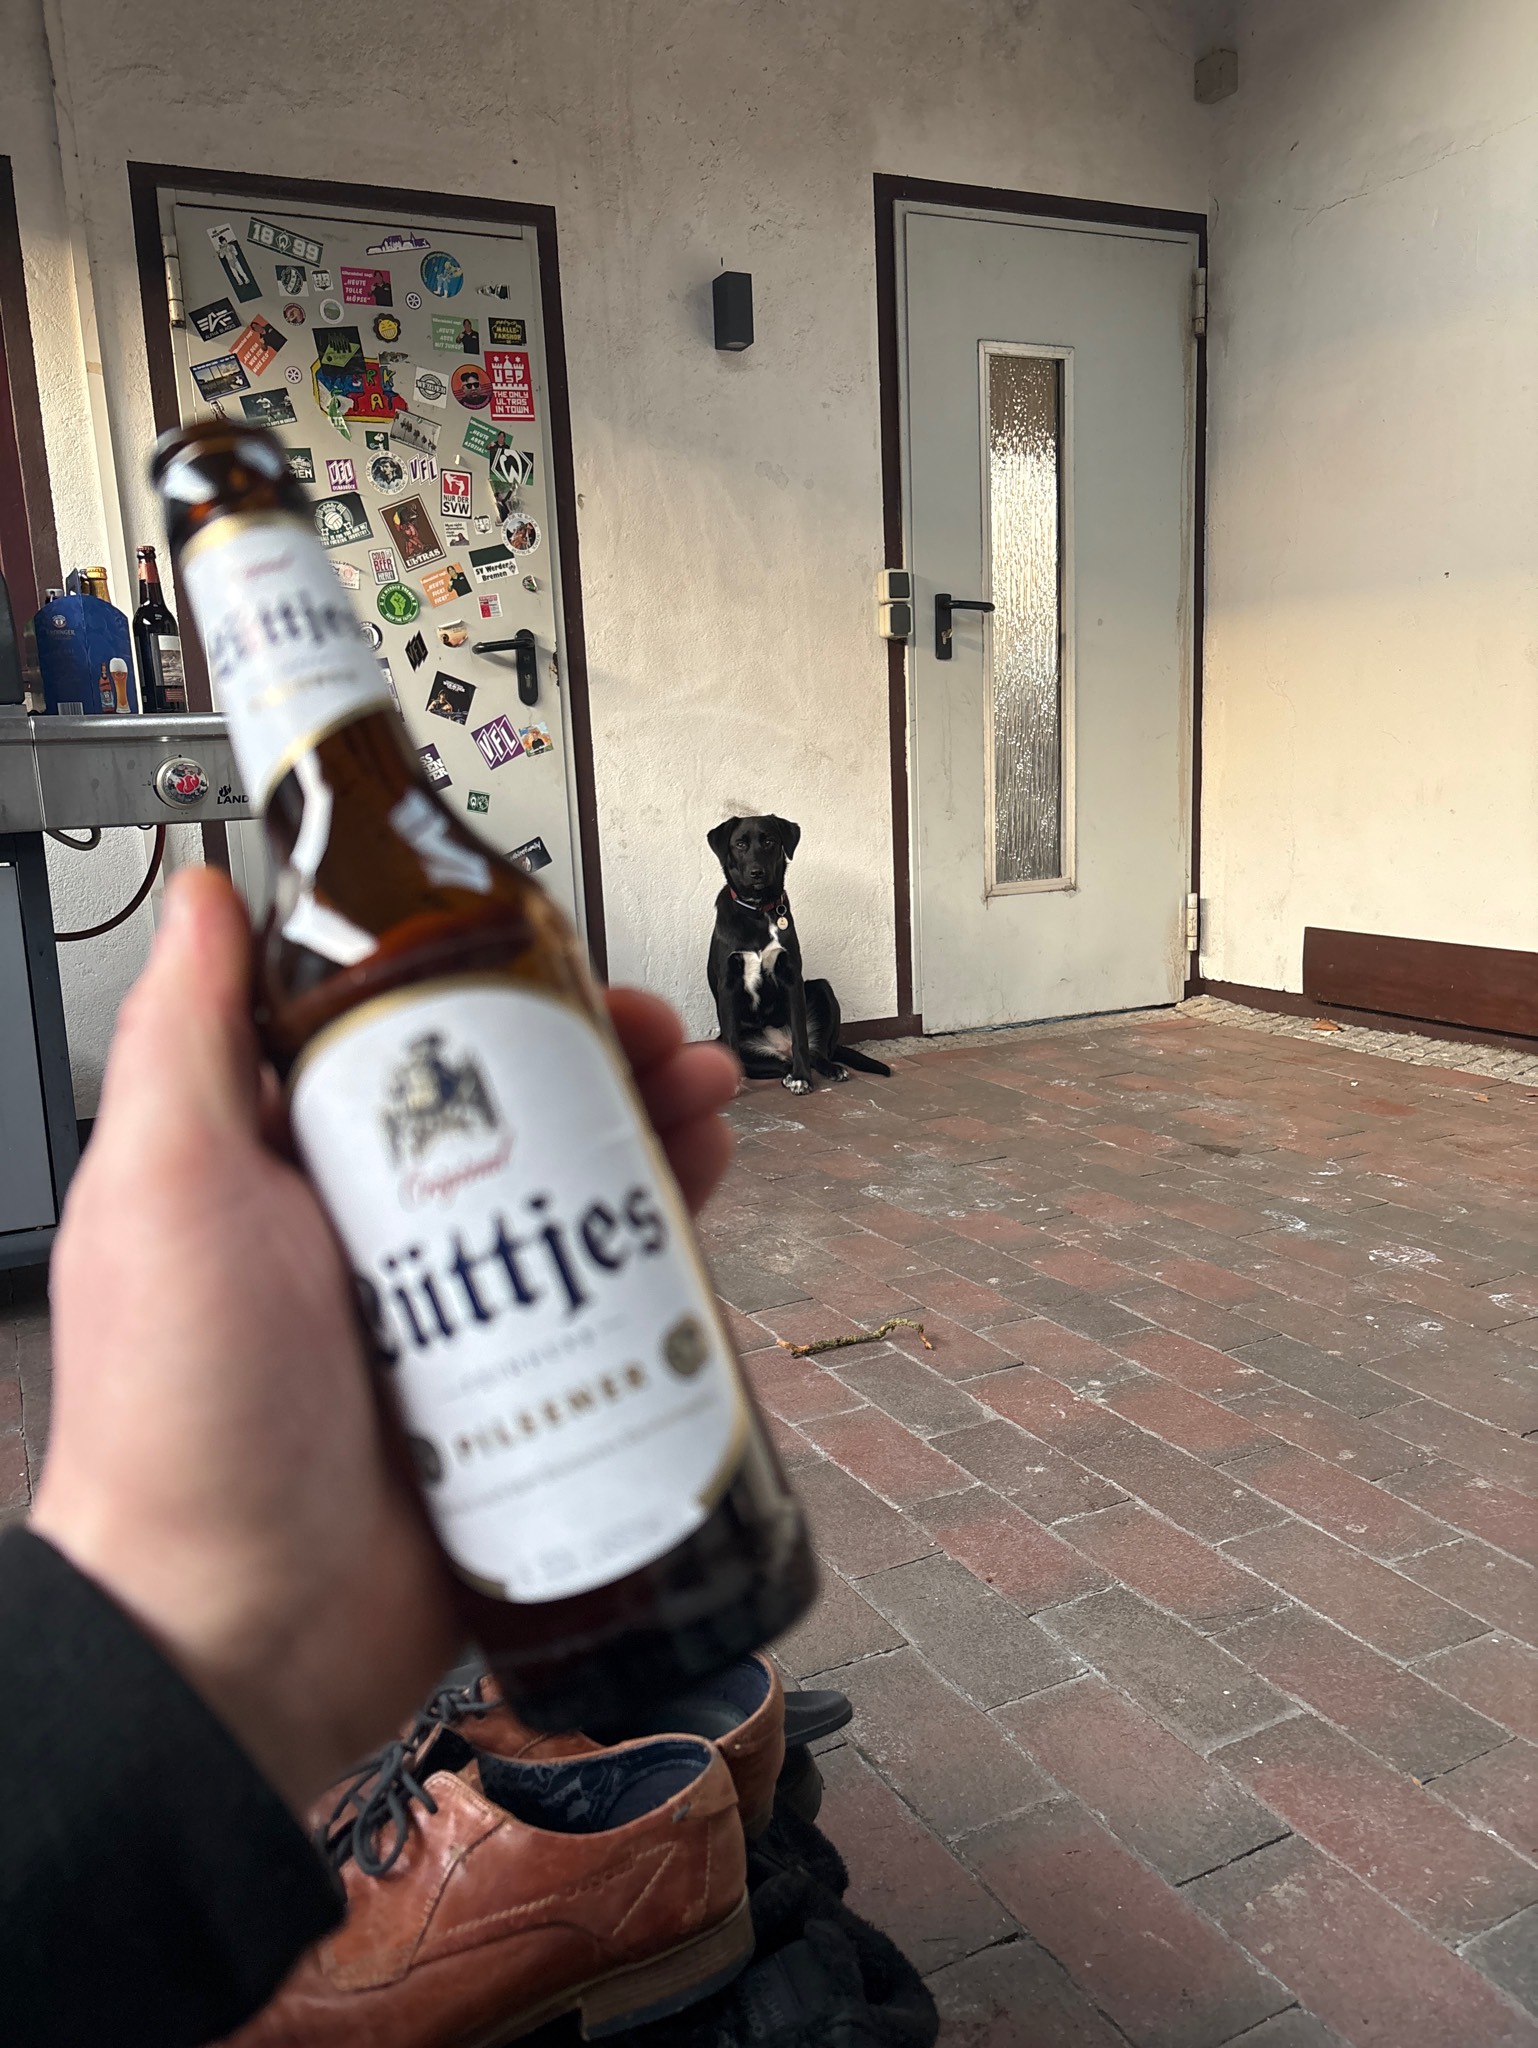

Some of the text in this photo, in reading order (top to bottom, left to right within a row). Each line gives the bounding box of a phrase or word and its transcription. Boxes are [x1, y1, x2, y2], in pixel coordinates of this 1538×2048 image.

[252, 223, 275, 245] 18
[293, 240, 320, 262] 99
[494, 370, 523, 383] USP
[508, 391, 529, 399] ONLY
[505, 406, 530, 414] TOWN
[470, 437, 485, 446] ABER
[410, 459, 437, 480] VFL
[443, 501, 470, 514] SVW
[372, 551, 386, 560] COLD
[405, 549, 441, 567] ULTRAS
[374, 559, 394, 571] BEER
[475, 561, 509, 576] SV Werder
[482, 571, 508, 581] Bremen
[479, 726, 516, 761] VFL
[217, 795, 250, 805] LAND
